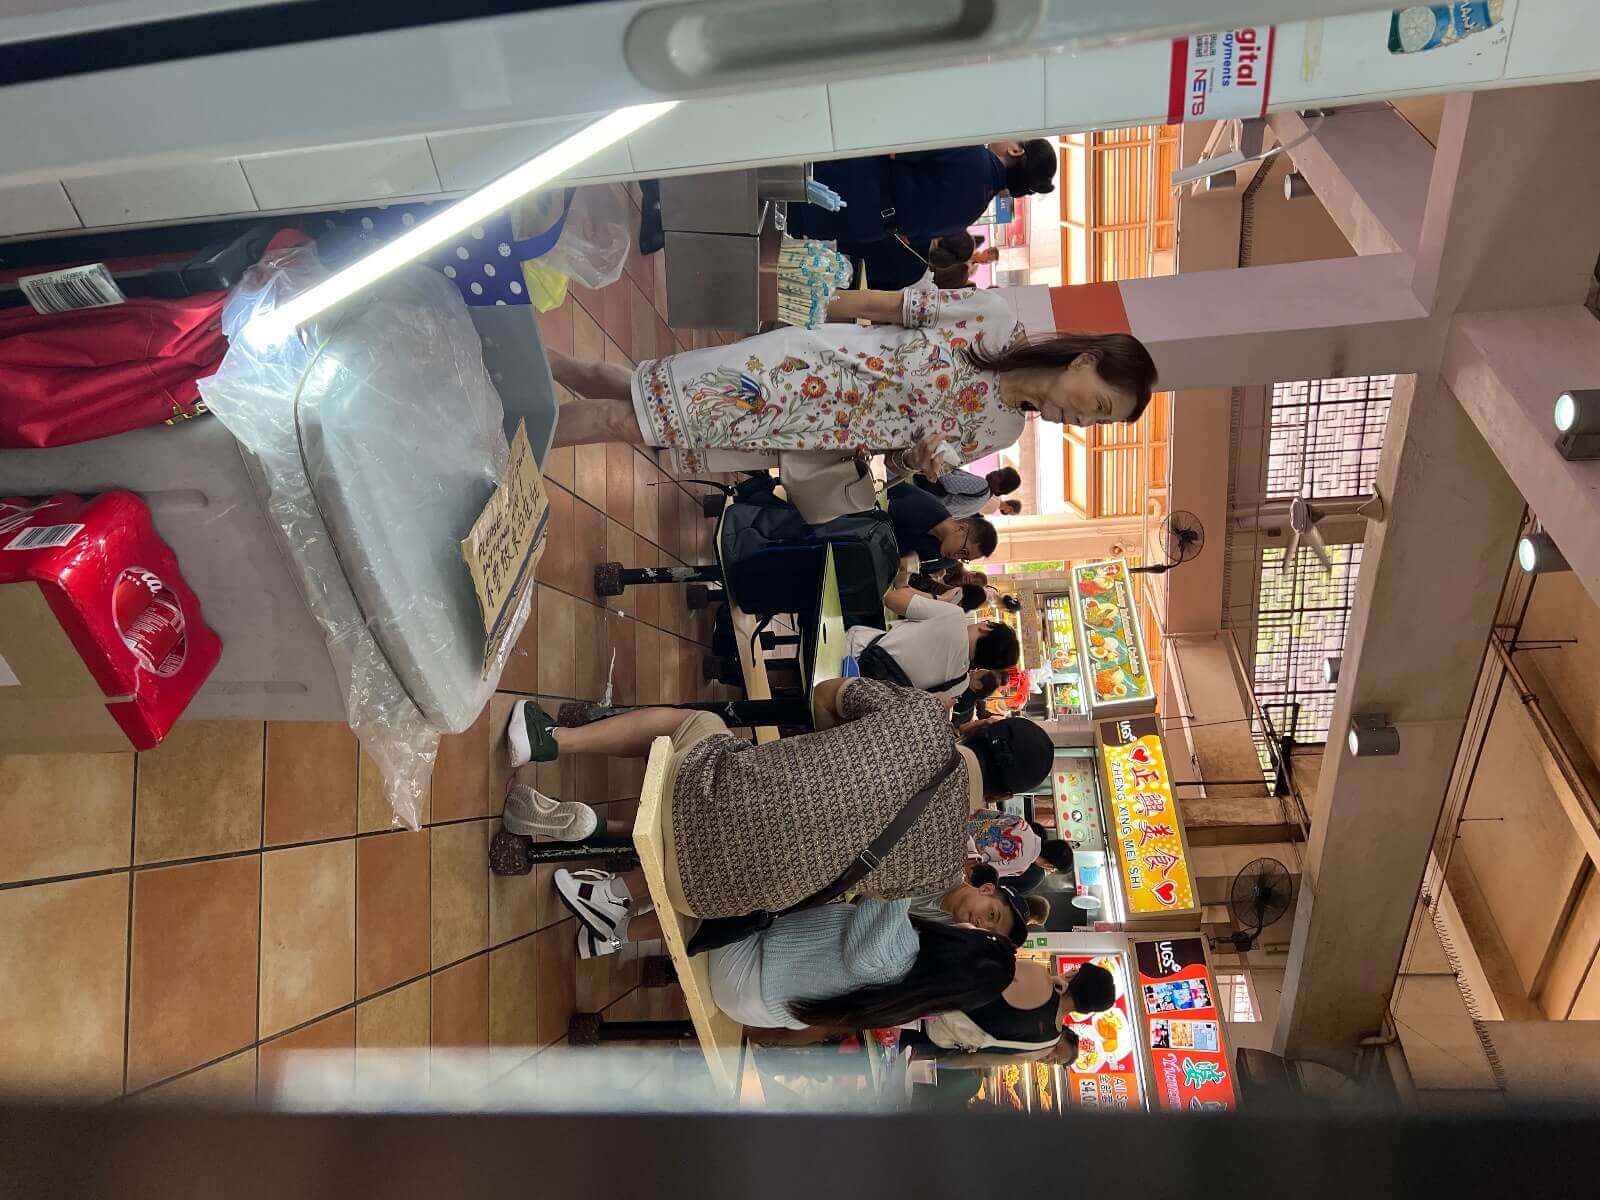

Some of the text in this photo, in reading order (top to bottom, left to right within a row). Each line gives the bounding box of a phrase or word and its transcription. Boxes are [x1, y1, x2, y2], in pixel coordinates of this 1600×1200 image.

[1222, 30, 1234, 87] ayments
[1192, 68, 1208, 116] NETS
[1111, 762, 1127, 801] ZHENG
[1118, 805, 1133, 835] XING
[1131, 767, 1181, 878] 正興美食
[1124, 840, 1138, 864] MEI
[1128, 867, 1142, 889] SHI
[1159, 941, 1175, 967] UGS
